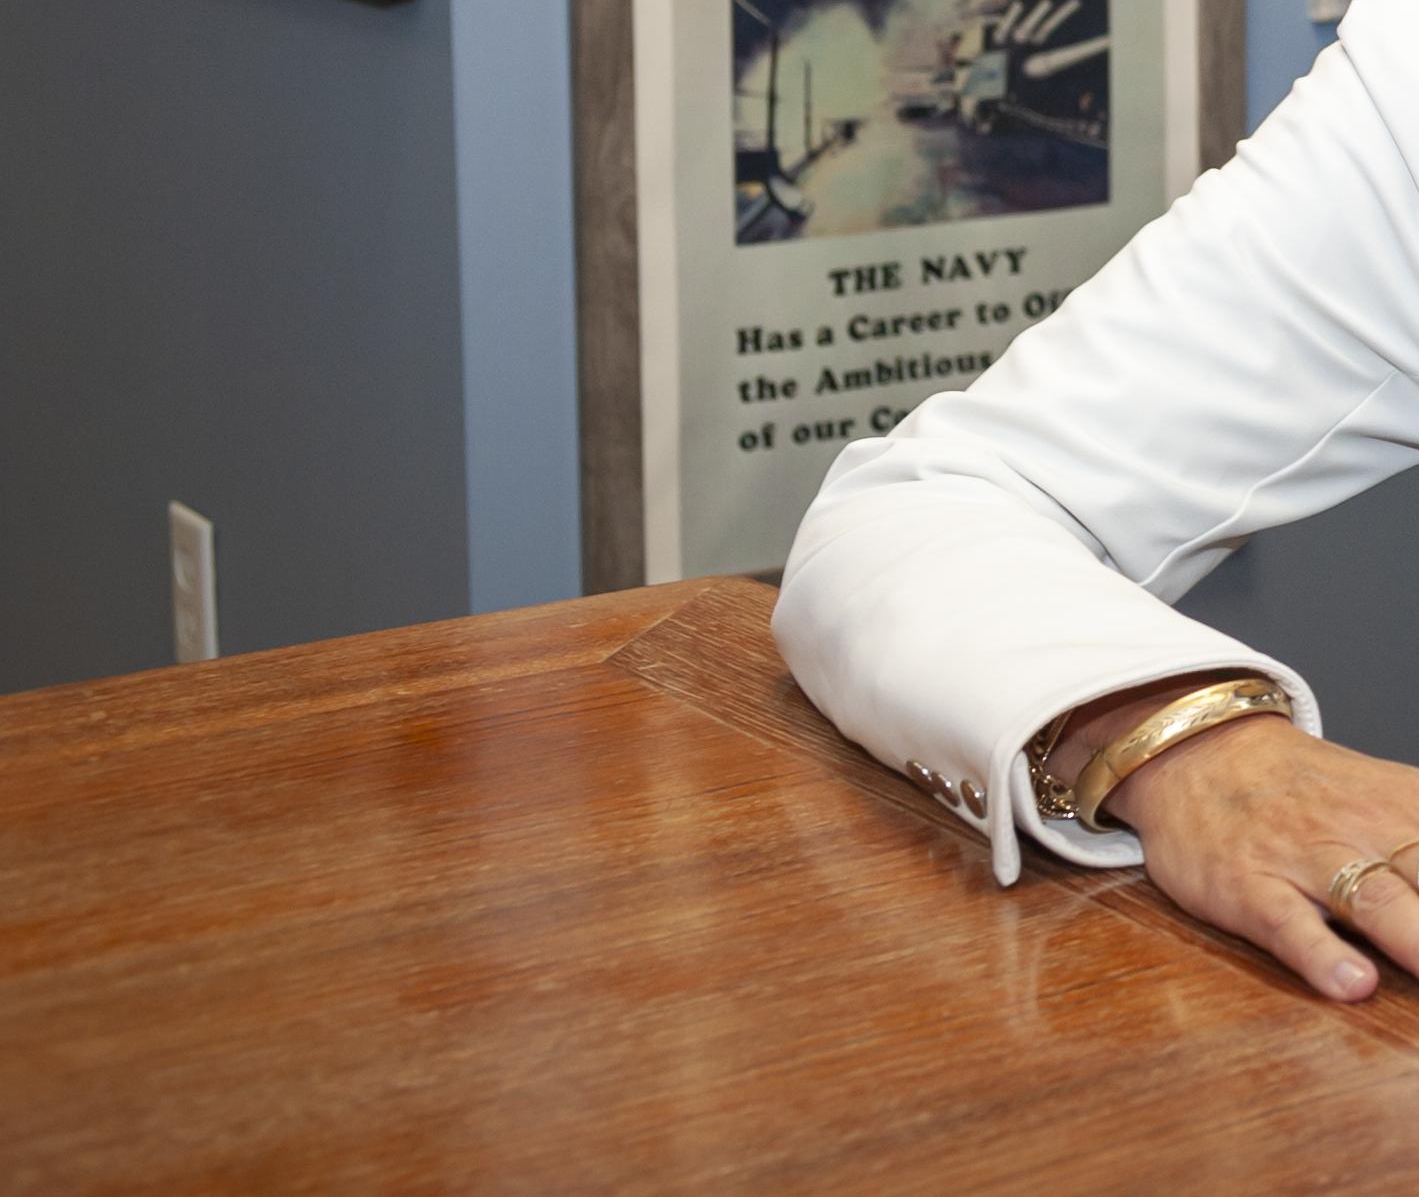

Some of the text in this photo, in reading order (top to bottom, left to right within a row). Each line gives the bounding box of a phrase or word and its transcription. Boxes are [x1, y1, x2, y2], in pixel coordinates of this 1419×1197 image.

[828, 246, 1027, 298] THE NAVY
[736, 289, 1068, 355] Has a Career to Of
[738, 350, 992, 403] the Ambitious
[738, 423, 776, 452] of
[792, 415, 855, 445] our
